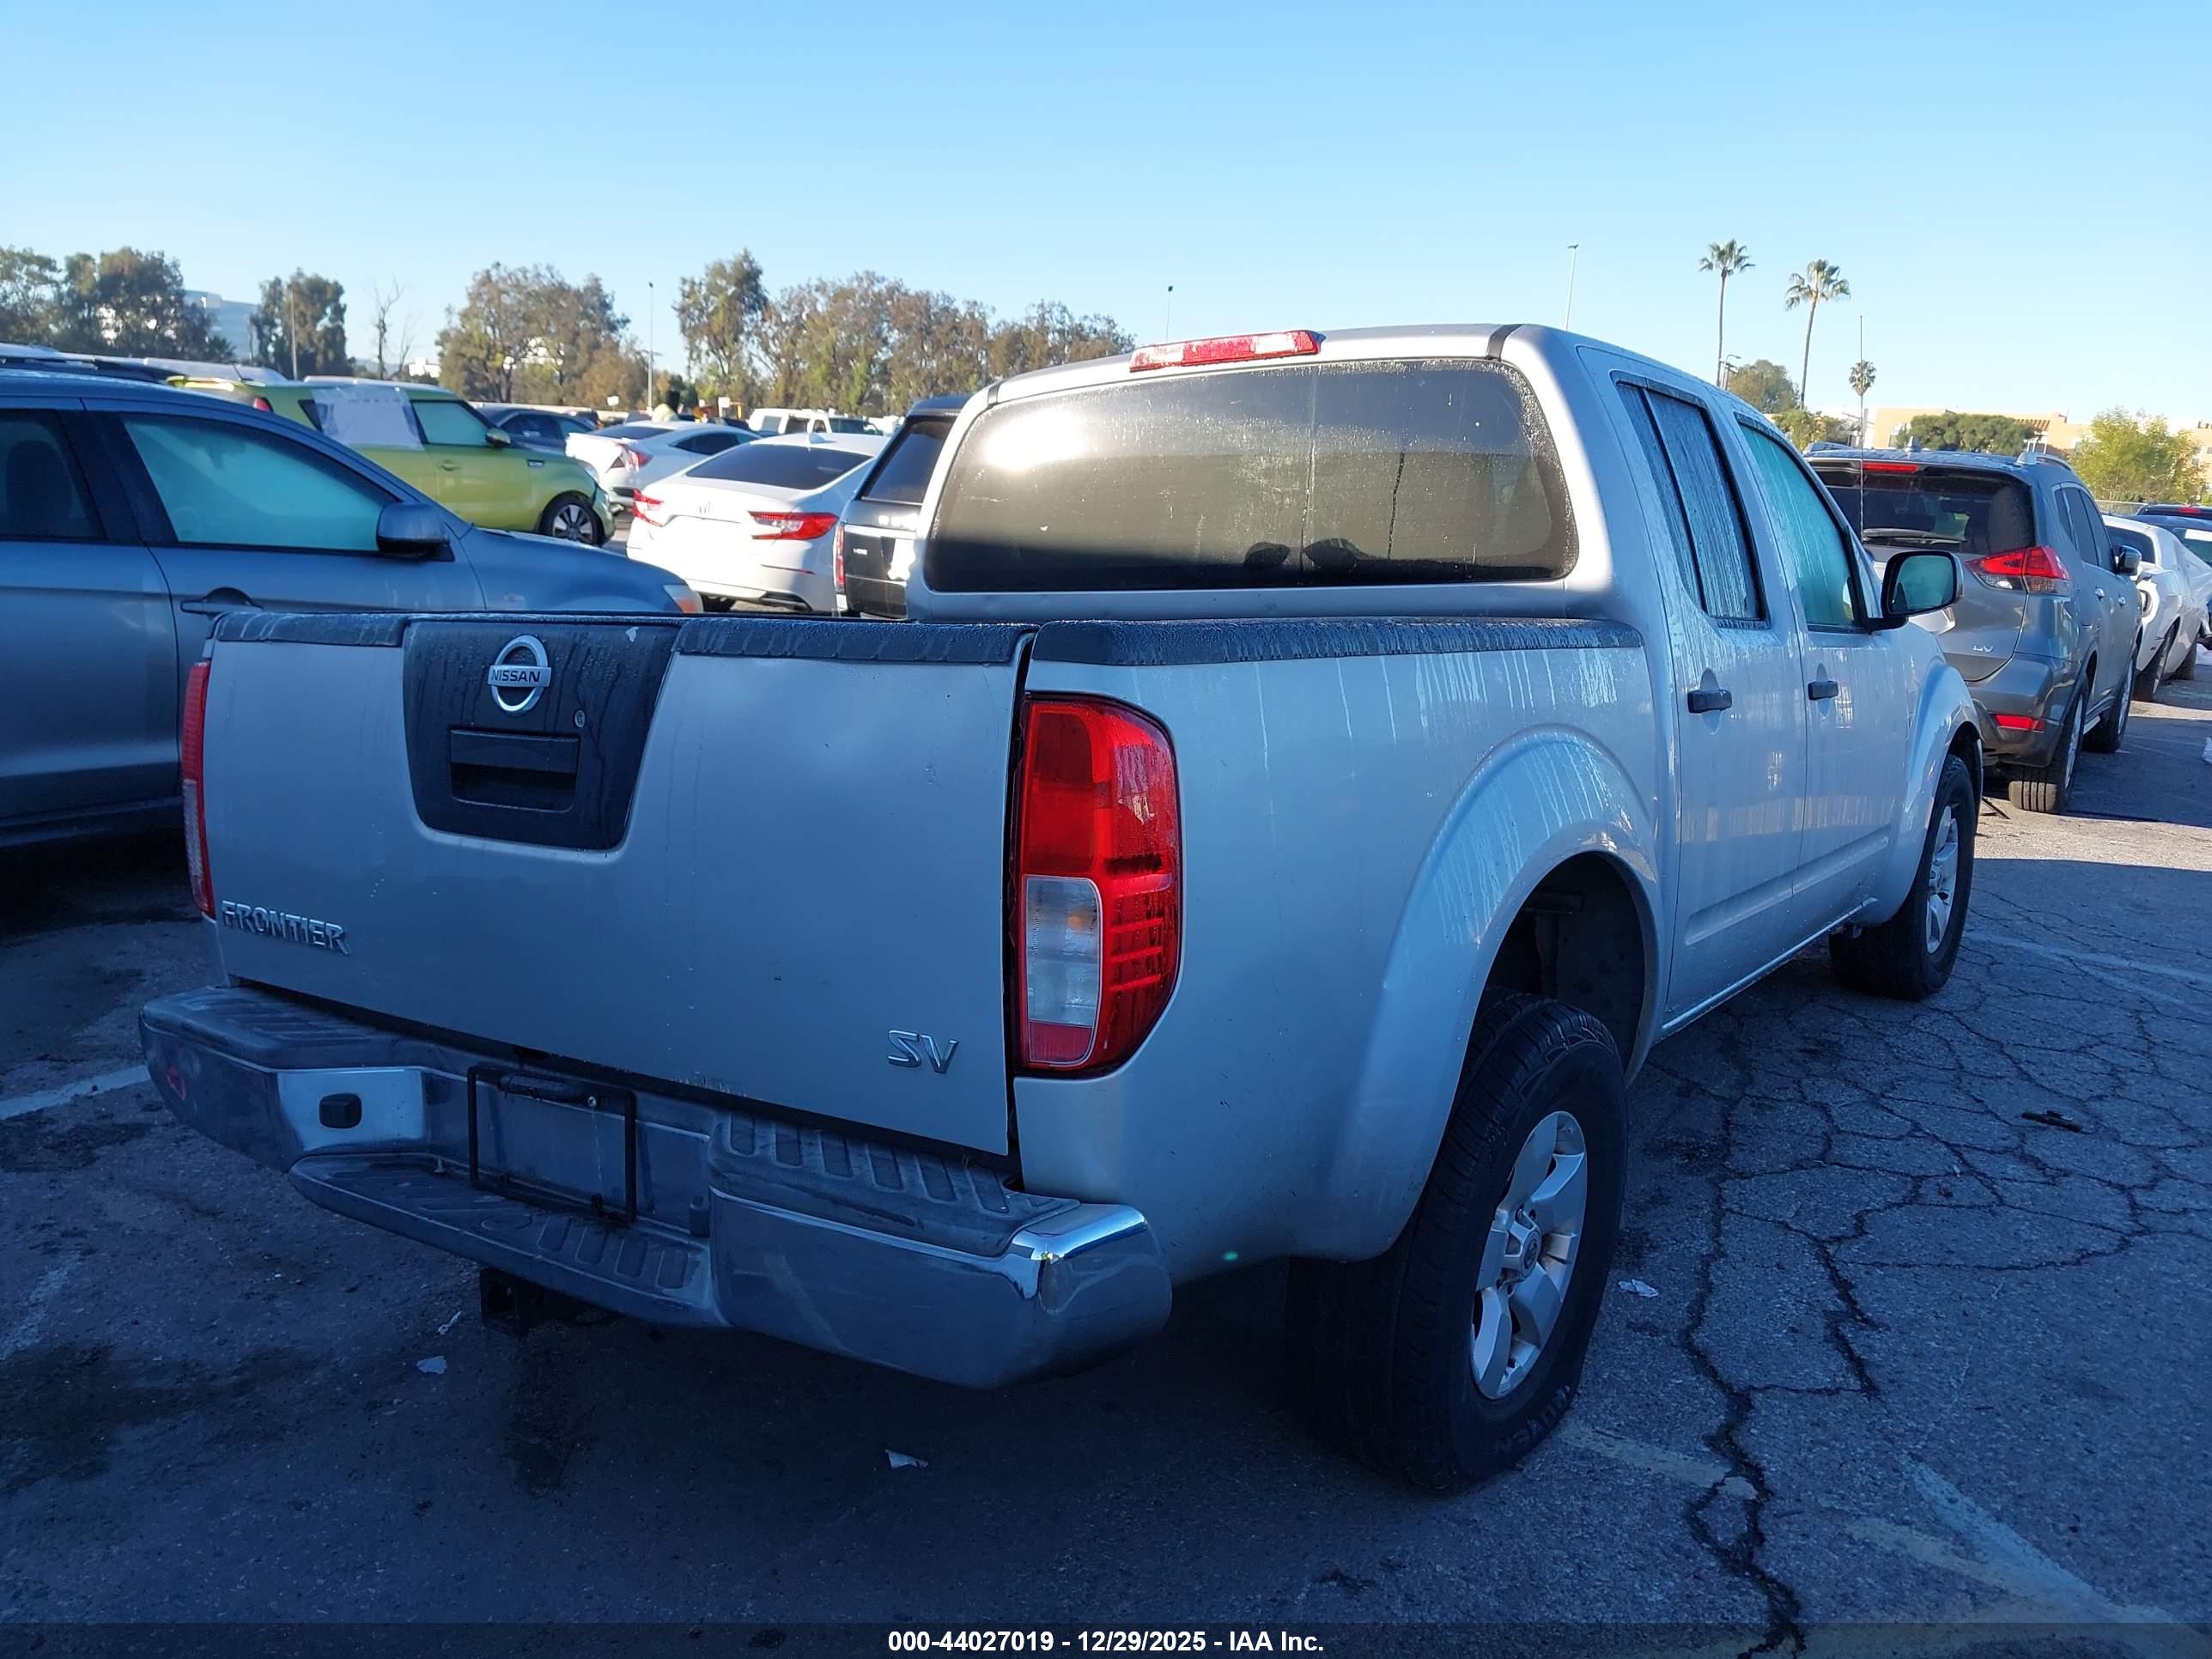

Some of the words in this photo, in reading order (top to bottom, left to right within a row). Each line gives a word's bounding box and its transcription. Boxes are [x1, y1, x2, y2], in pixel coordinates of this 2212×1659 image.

[491, 669, 541, 683] NISSAN
[222, 900, 350, 955] FRONTIER
[888, 1030, 958, 1074] SV
